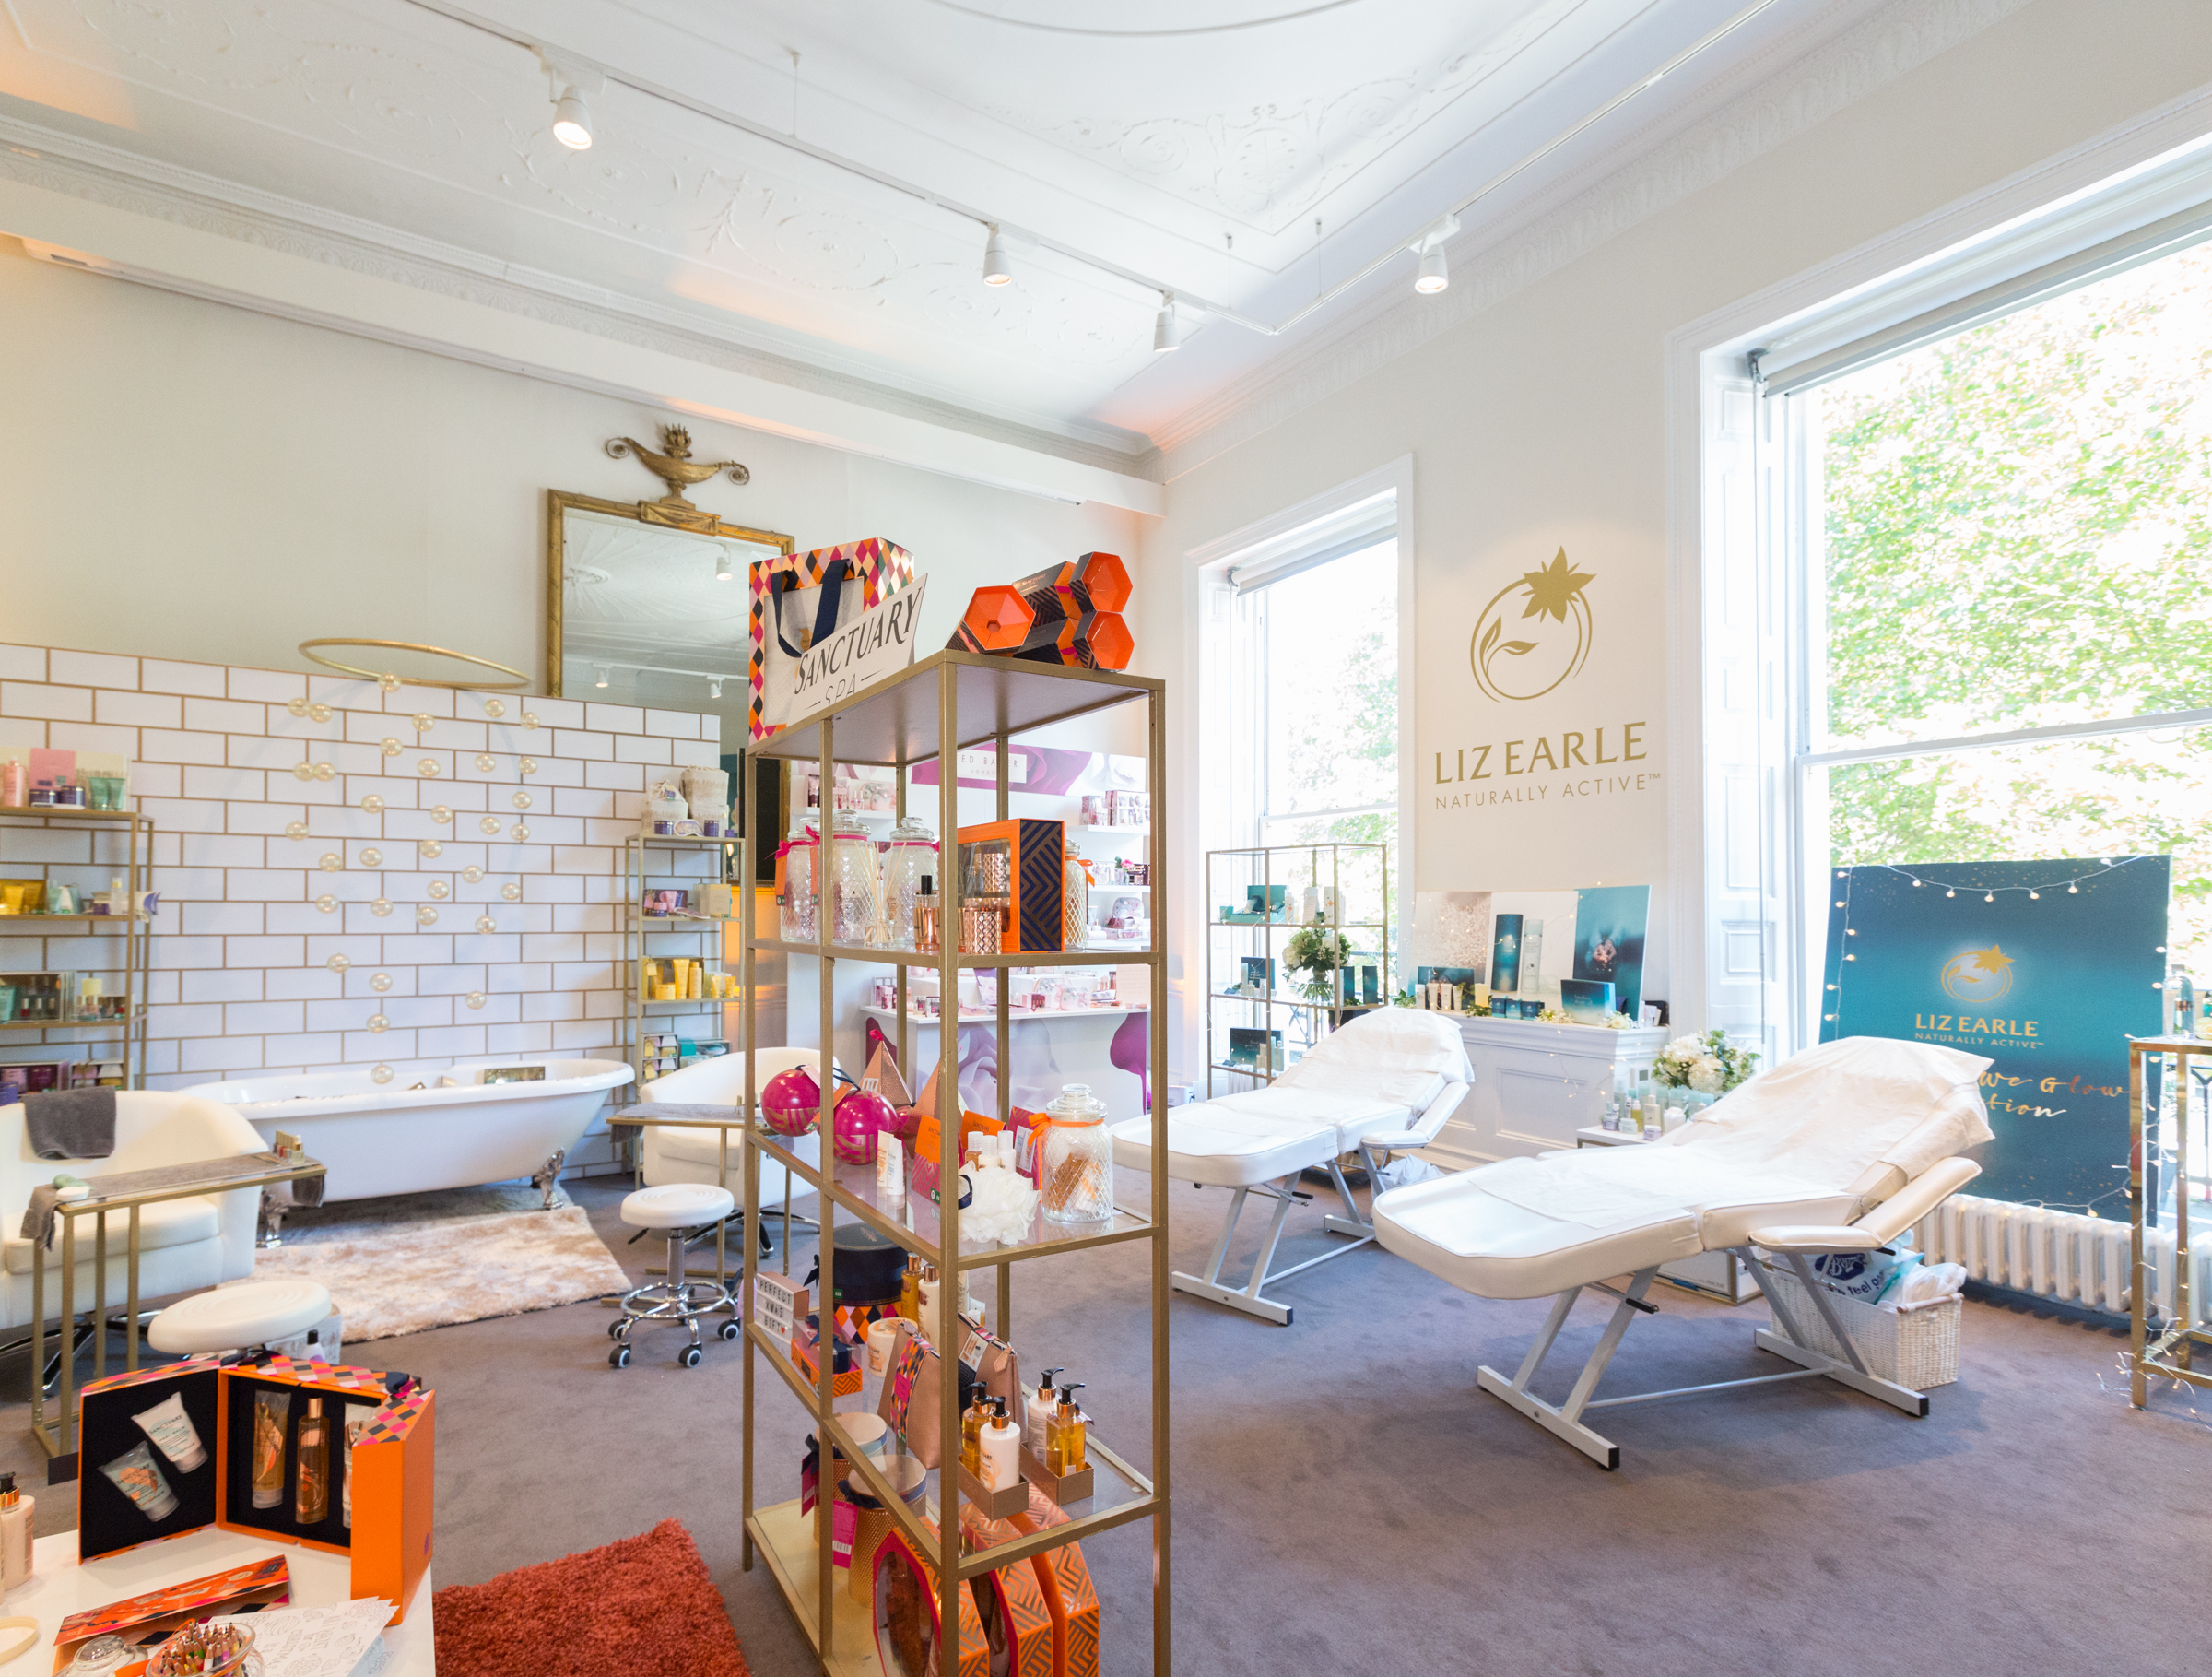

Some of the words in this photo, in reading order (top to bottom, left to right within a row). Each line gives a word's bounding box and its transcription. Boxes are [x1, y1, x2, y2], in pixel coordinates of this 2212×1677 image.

[794, 586, 923, 694] SANCTUARY
[826, 673, 856, 706] SPA
[961, 755, 974, 764] ED
[983, 756, 1018, 768] BAR
[1435, 745, 1493, 785] LIZ
[1505, 721, 1648, 775] EARLE
[1436, 785, 1548, 810] NATURALLY
[1915, 1013, 1952, 1031] LIZ
[1958, 1016, 2039, 1037] EARLE
[1914, 1033, 1984, 1045] NATURALLY
[2040, 1075, 2131, 1098] Glow
[759, 1280, 791, 1305] PERFECT
[765, 1300, 783, 1318] XMAS
[763, 1315, 782, 1333] GIFT
